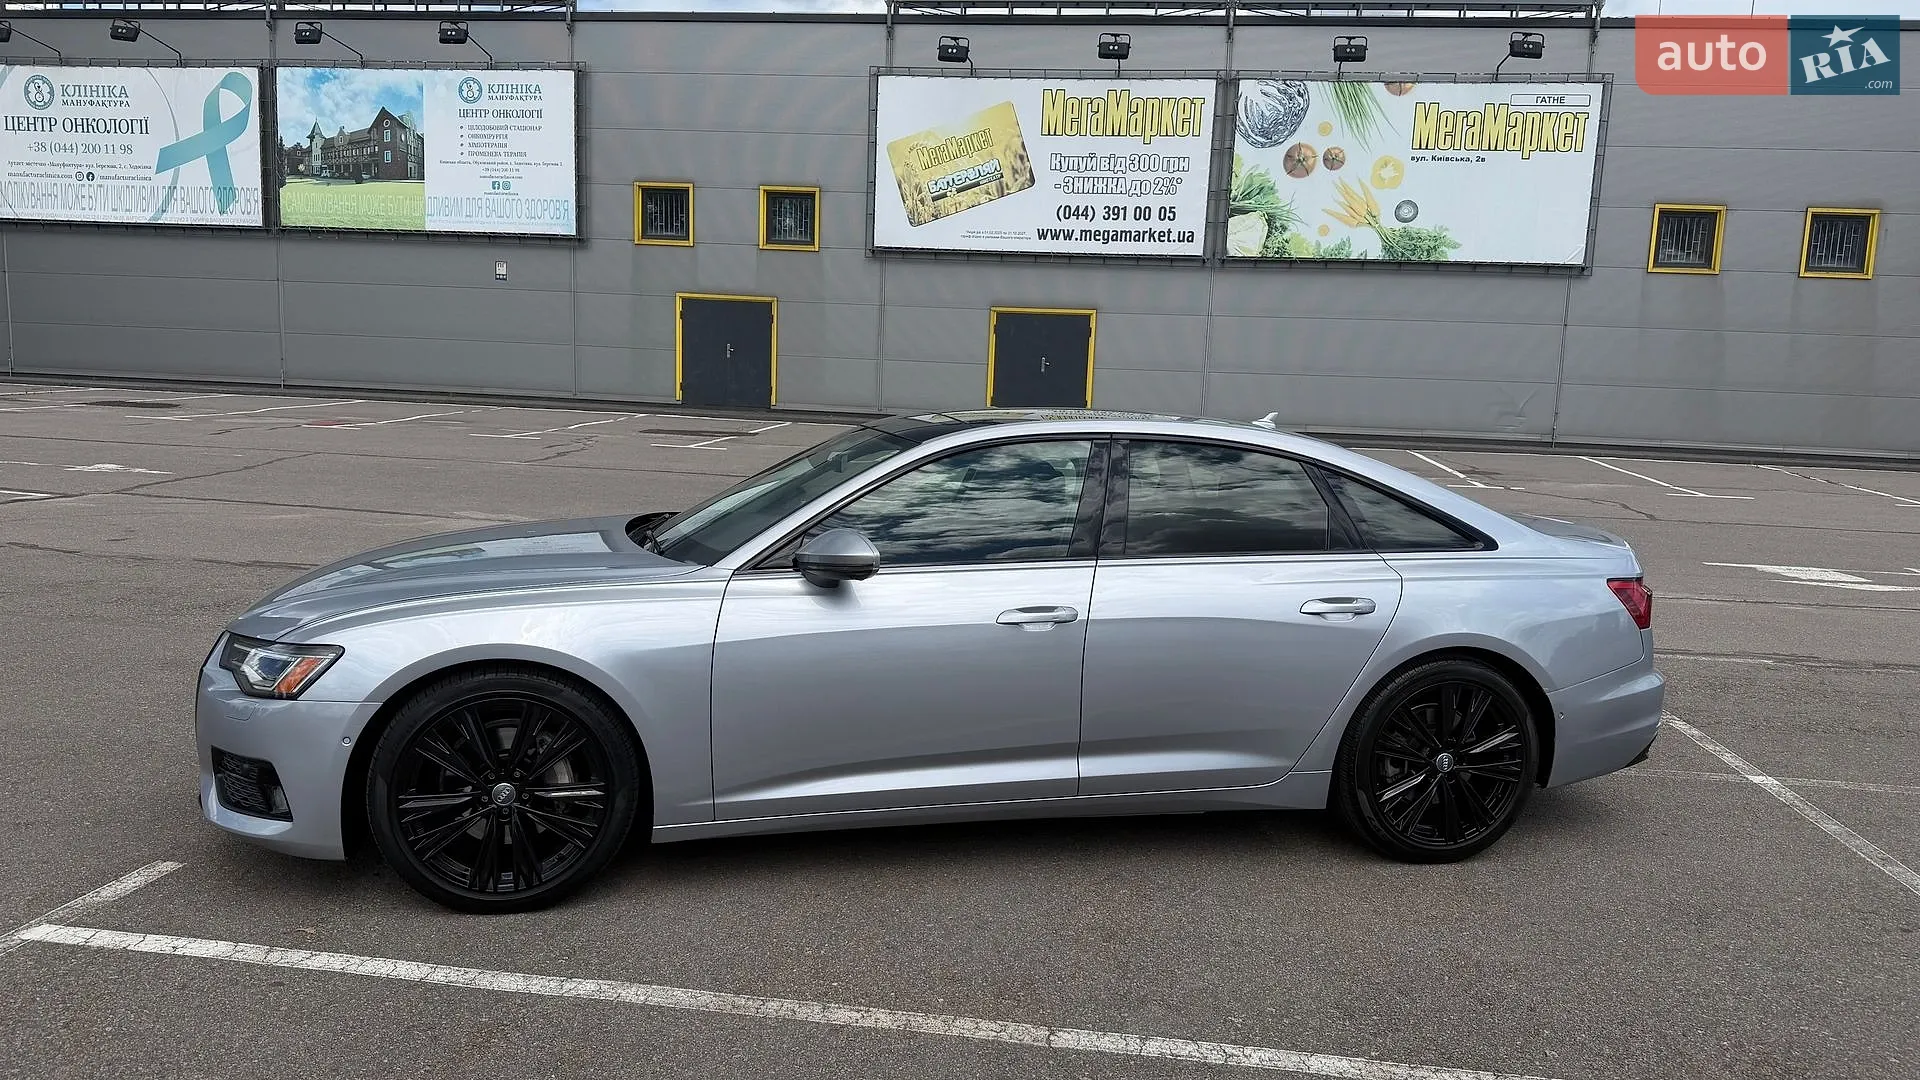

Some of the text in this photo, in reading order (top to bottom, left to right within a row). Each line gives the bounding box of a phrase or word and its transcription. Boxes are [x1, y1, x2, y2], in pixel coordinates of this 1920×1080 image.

[60, 84, 129, 98] КЛІНІКА
[487, 83, 542, 94] КЛІНІКА
[61, 99, 130, 108] МАНУФАКТУРА
[1535, 96, 1566, 104] ГАТНЕ
[458, 108, 543, 119] ЦЕНТР ОНКОЛОГІЇ
[1040, 88, 1205, 145] МегаМаркет
[4, 115, 150, 135] ЦЕНТР ОНКОЛОГІЇ
[1411, 101, 1590, 160] МегаМаркет
[27, 141, 133, 155] +38 (044) 200 11 98
[916, 128, 994, 170] МегаМаркет
[1050, 152, 1190, 174] Купуй від 300 грн
[1063, 176, 1127, 195] ЗНИЖКА
[1128, 179, 1150, 197] до
[485, 197, 522, 220] ВАШОГО
[1056, 204, 1177, 222] (044) 391 00 05
[1037, 227, 1195, 245] www.megamarket.ua
